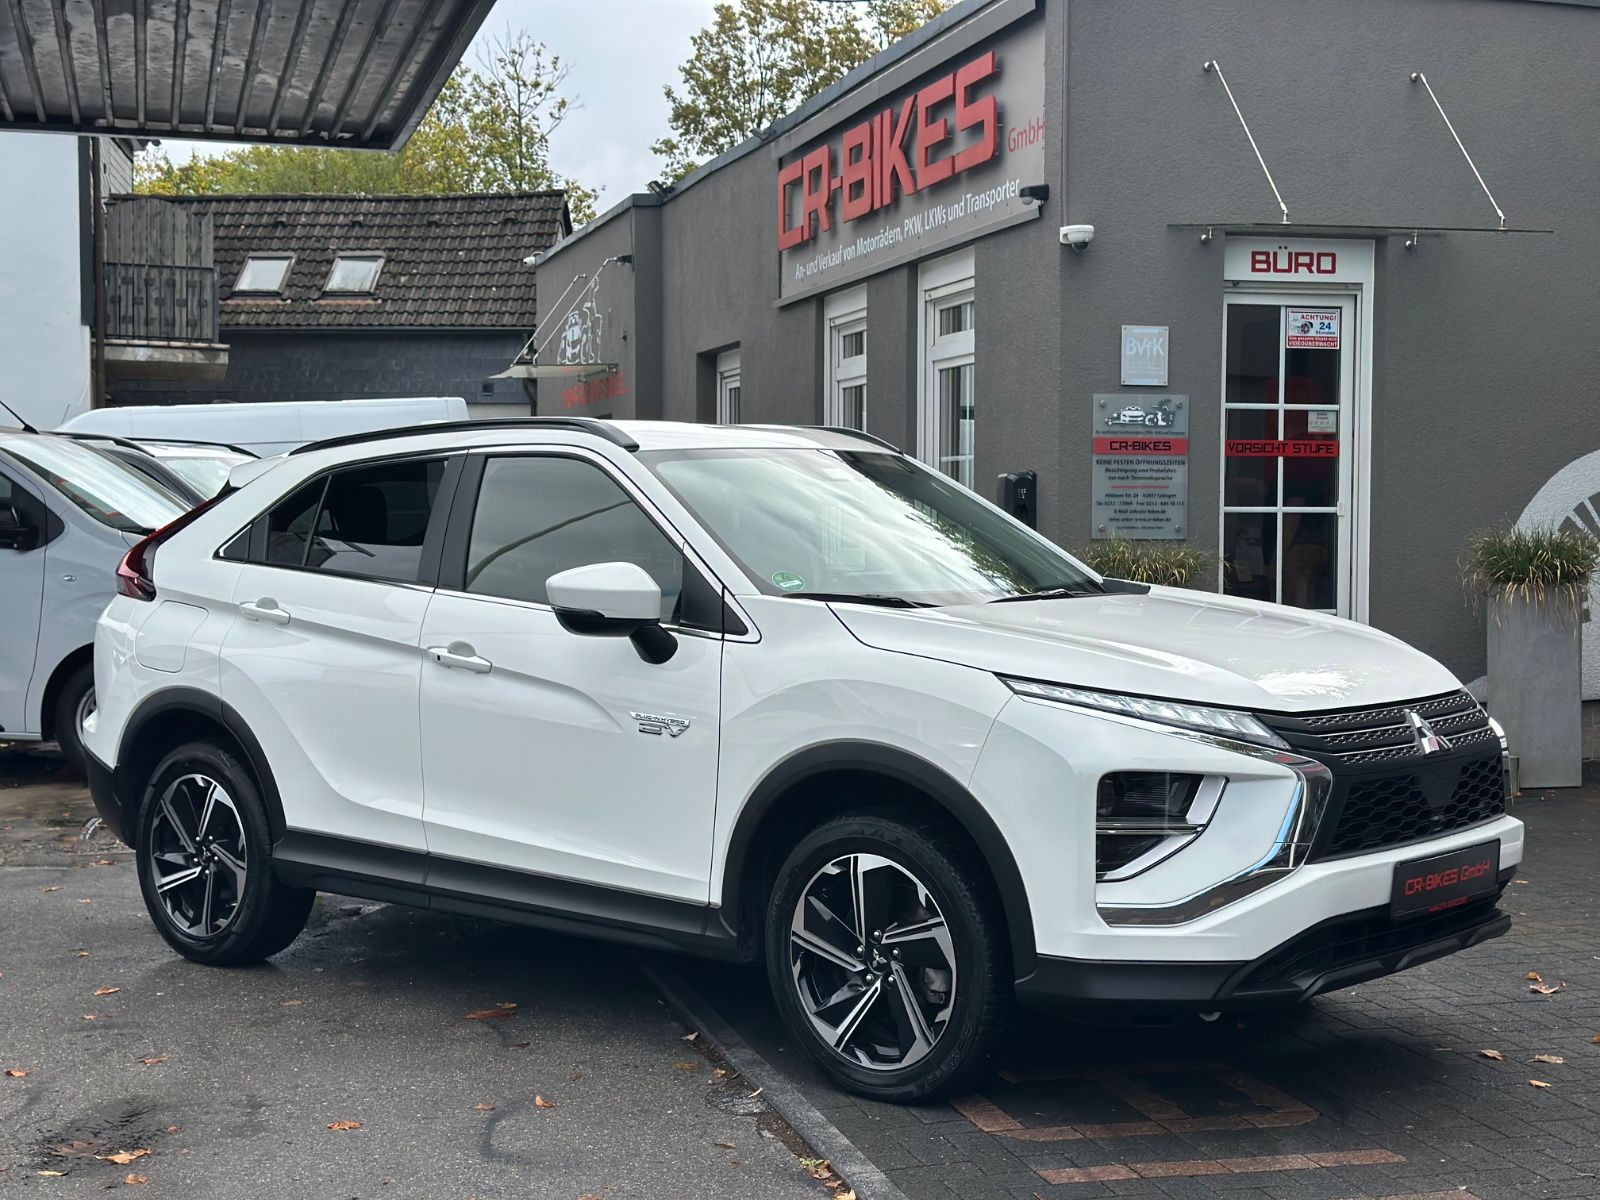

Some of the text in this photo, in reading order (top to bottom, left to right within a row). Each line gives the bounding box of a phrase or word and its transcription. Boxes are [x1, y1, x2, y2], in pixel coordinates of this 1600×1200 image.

[778, 51, 1045, 252] CR-BIKES GmbH
[806, 254, 818, 275] und
[819, 245, 842, 273] Verkauf
[843, 246, 855, 261] von
[856, 226, 903, 256] Motorrädern,
[904, 213, 923, 238] PKW,
[947, 195, 965, 221] und
[966, 178, 1020, 212] Transporter
[1251, 245, 1337, 275] BÜRO
[1319, 321, 1332, 330] 24
[1109, 441, 1172, 451] CR-BIKES
[1227, 443, 1334, 454] VORSICHT STUFE
[1405, 859, 1490, 896] CR-BIKES GmbH
